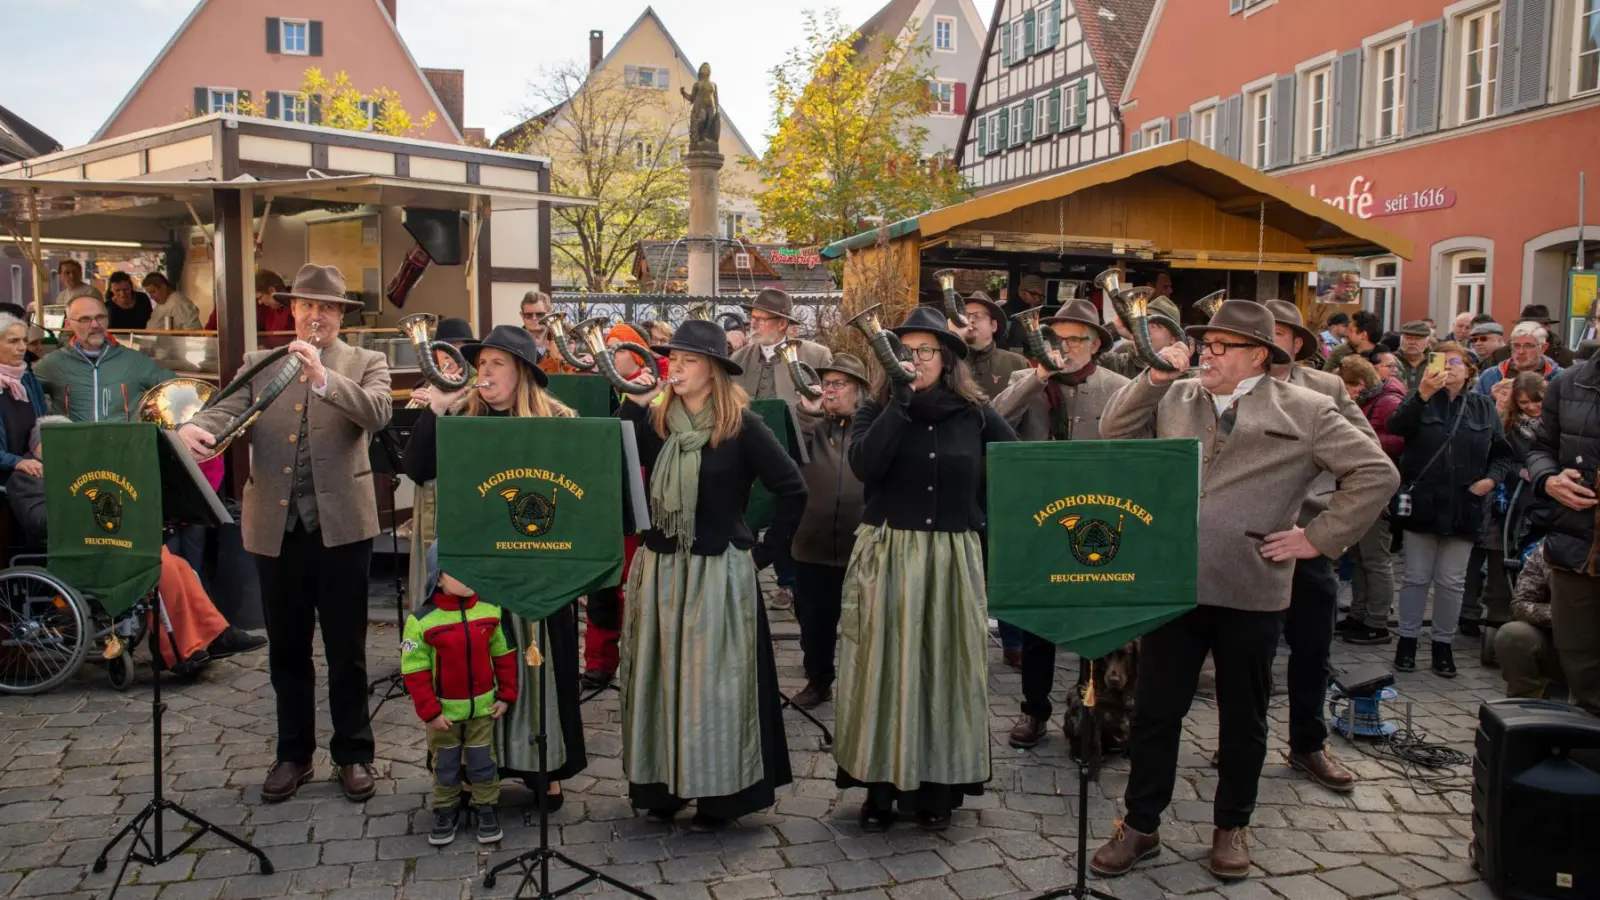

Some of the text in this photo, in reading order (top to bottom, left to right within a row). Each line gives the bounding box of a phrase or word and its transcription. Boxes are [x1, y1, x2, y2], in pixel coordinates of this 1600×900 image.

[1385, 194, 1408, 212] seit
[1413, 187, 1444, 209] 1616
[69, 470, 138, 501] JAGDHORNBLÄSER
[477, 468, 584, 500] JAGDHORNBLÄSER
[1033, 494, 1153, 527] JAGDHORNBLÄSER
[84, 537, 133, 549] FEUCHTWANGEN
[496, 541, 572, 550] FEUCHTWANGEN
[1050, 573, 1135, 583] FEUCHTWANGEN
